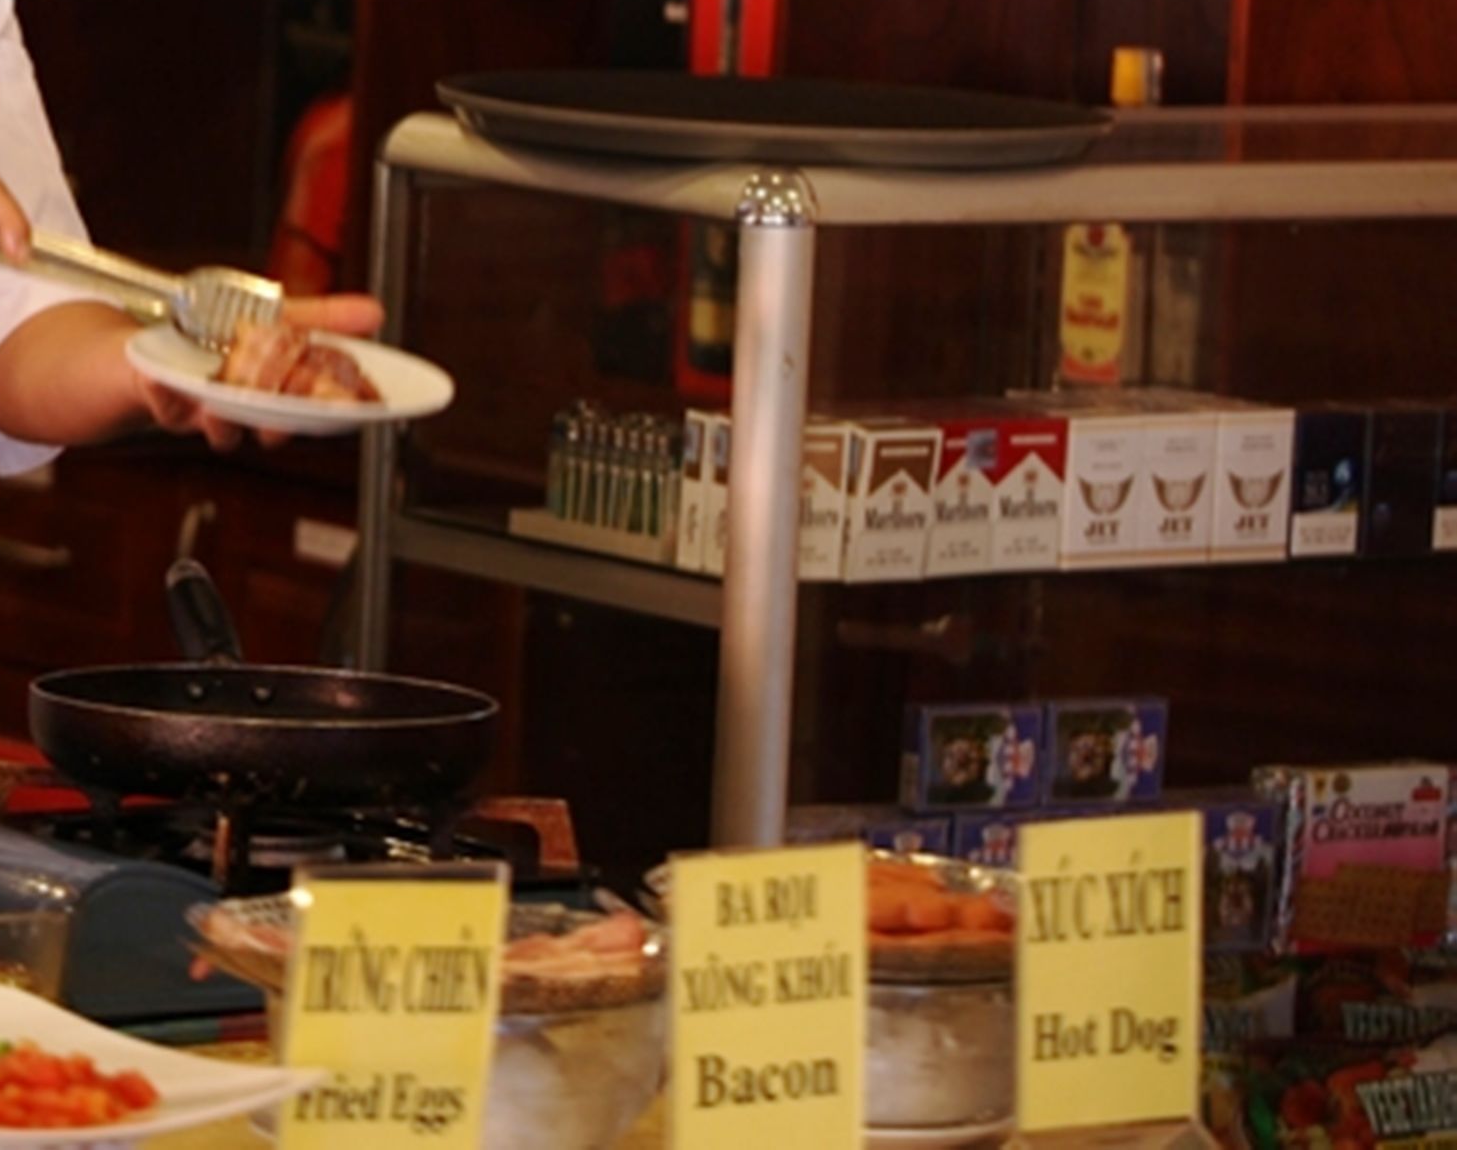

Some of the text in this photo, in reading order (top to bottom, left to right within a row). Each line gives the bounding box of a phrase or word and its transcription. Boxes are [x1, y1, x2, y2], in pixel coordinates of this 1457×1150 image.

[998, 487, 1058, 520] Marlboro
[1234, 513, 1270, 531] JET
[1084, 519, 1120, 538] JET
[1158, 516, 1193, 535] JET
[715, 881, 757, 927] BA
[1032, 1011, 1098, 1062] Hot
[1109, 1006, 1180, 1064] Dog
[695, 1053, 840, 1108] Bacon
[389, 1071, 467, 1134] Eggs
